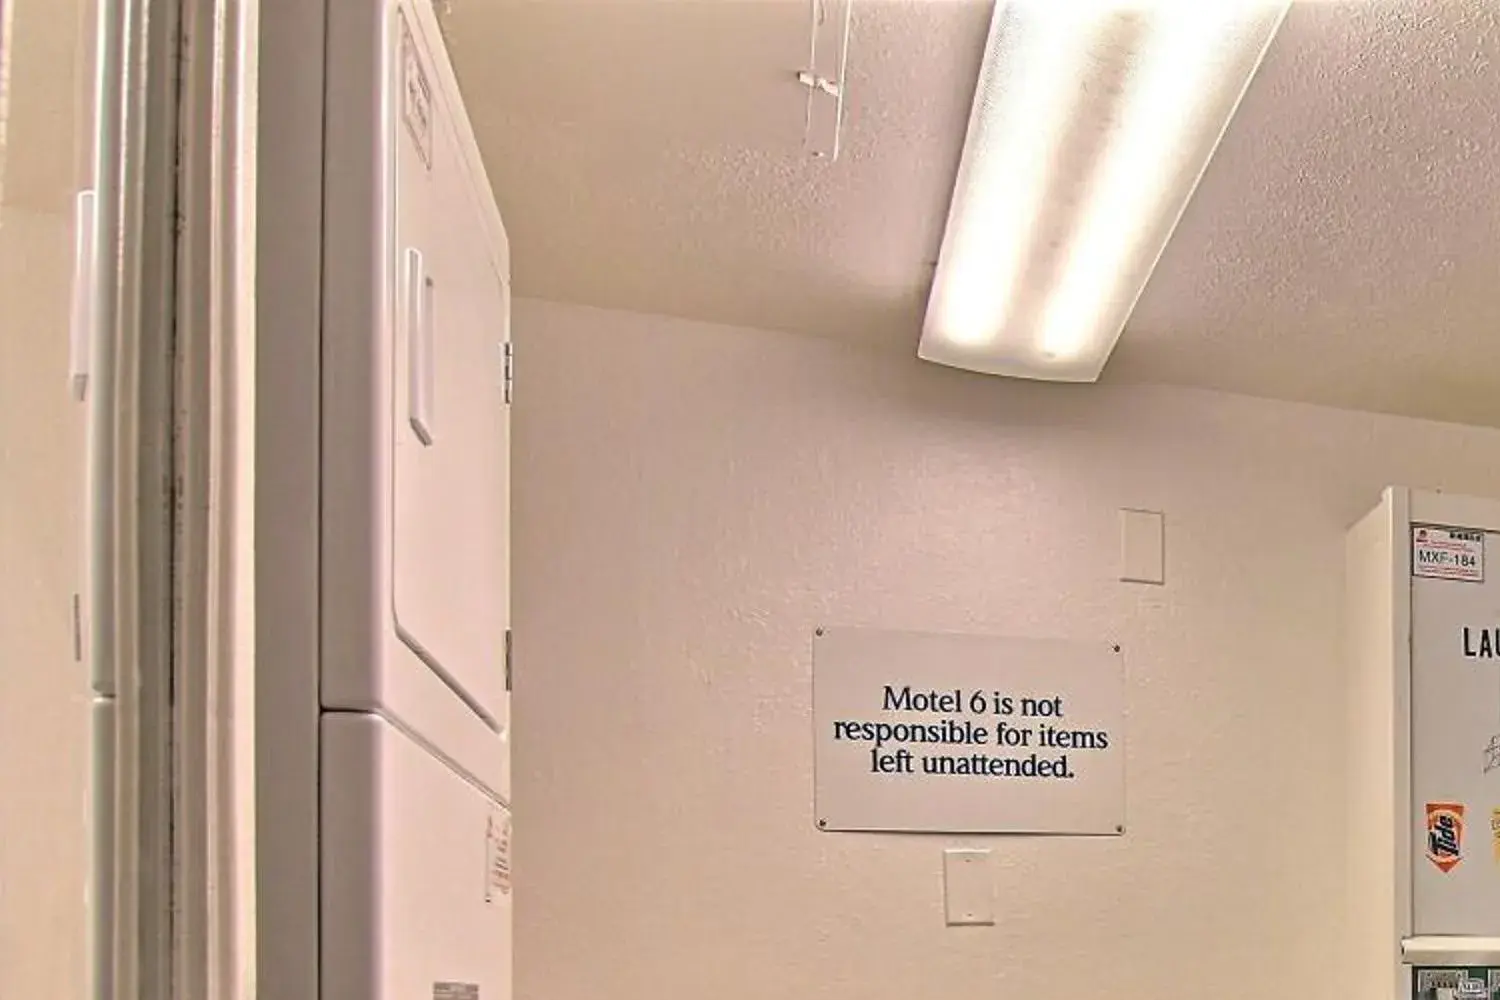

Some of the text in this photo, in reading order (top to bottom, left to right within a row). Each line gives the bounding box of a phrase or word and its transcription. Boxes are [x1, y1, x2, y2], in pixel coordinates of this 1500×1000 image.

[882, 686, 1064, 717] Motel 6 is not
[834, 719, 1108, 748] responsible for items
[870, 748, 1075, 779] left unattended.
[1427, 815, 1461, 858] Tide
